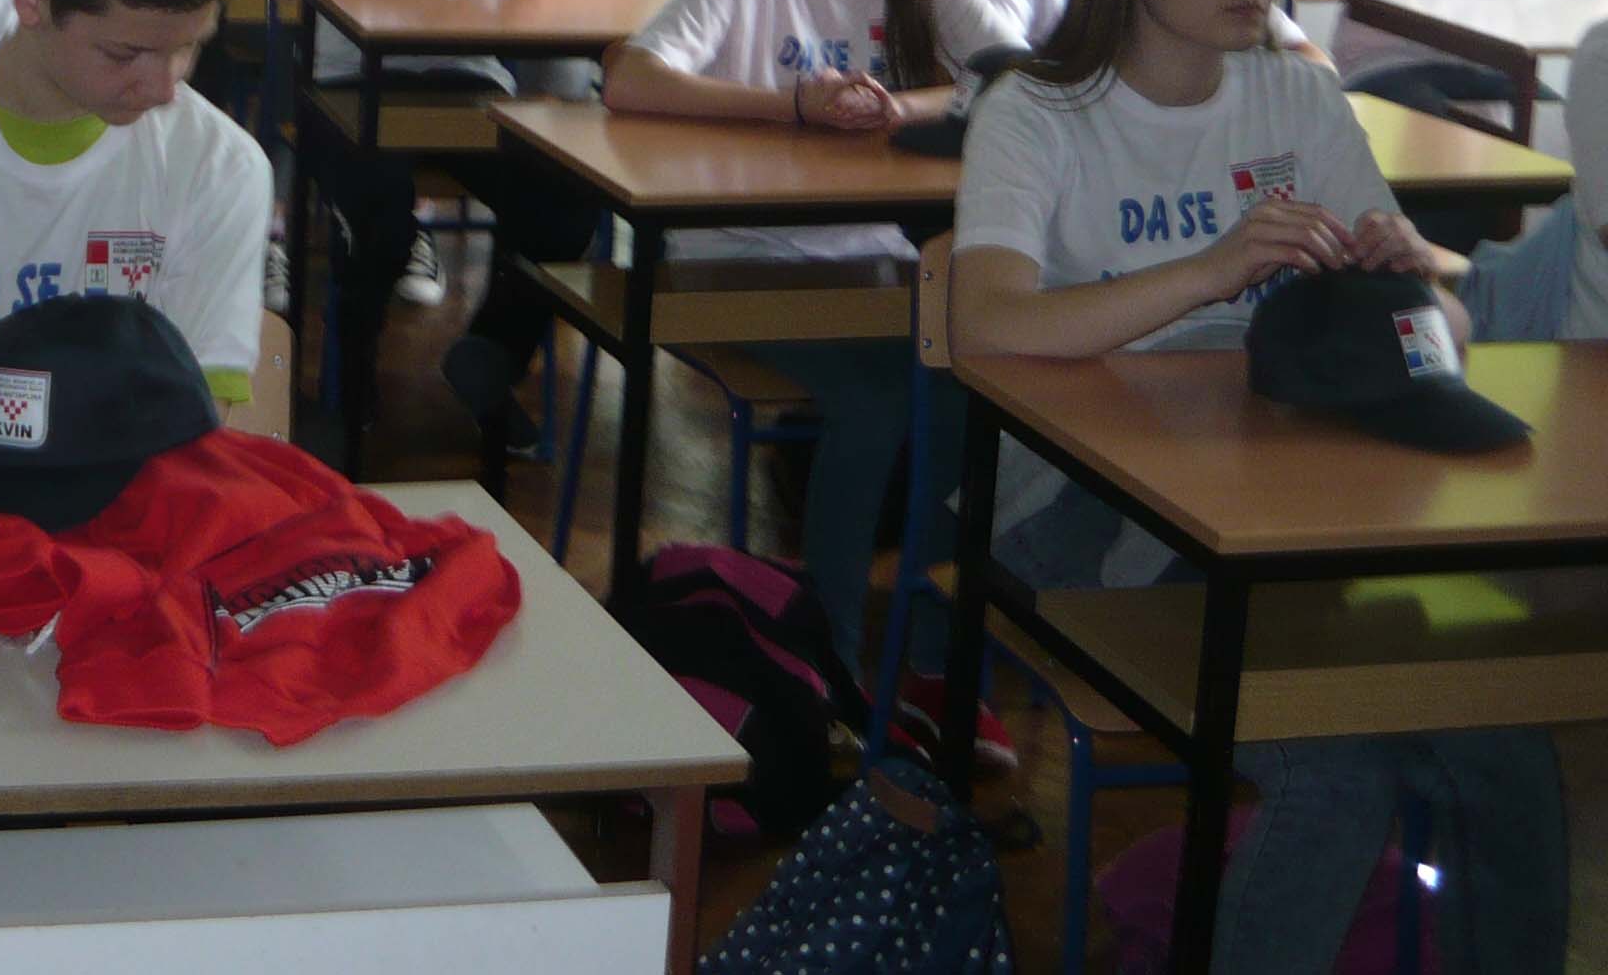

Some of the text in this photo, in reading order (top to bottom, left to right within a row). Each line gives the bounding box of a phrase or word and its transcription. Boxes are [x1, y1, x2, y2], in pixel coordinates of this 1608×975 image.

[1120, 191, 1218, 243] DA SE
[12, 262, 63, 313] SE
